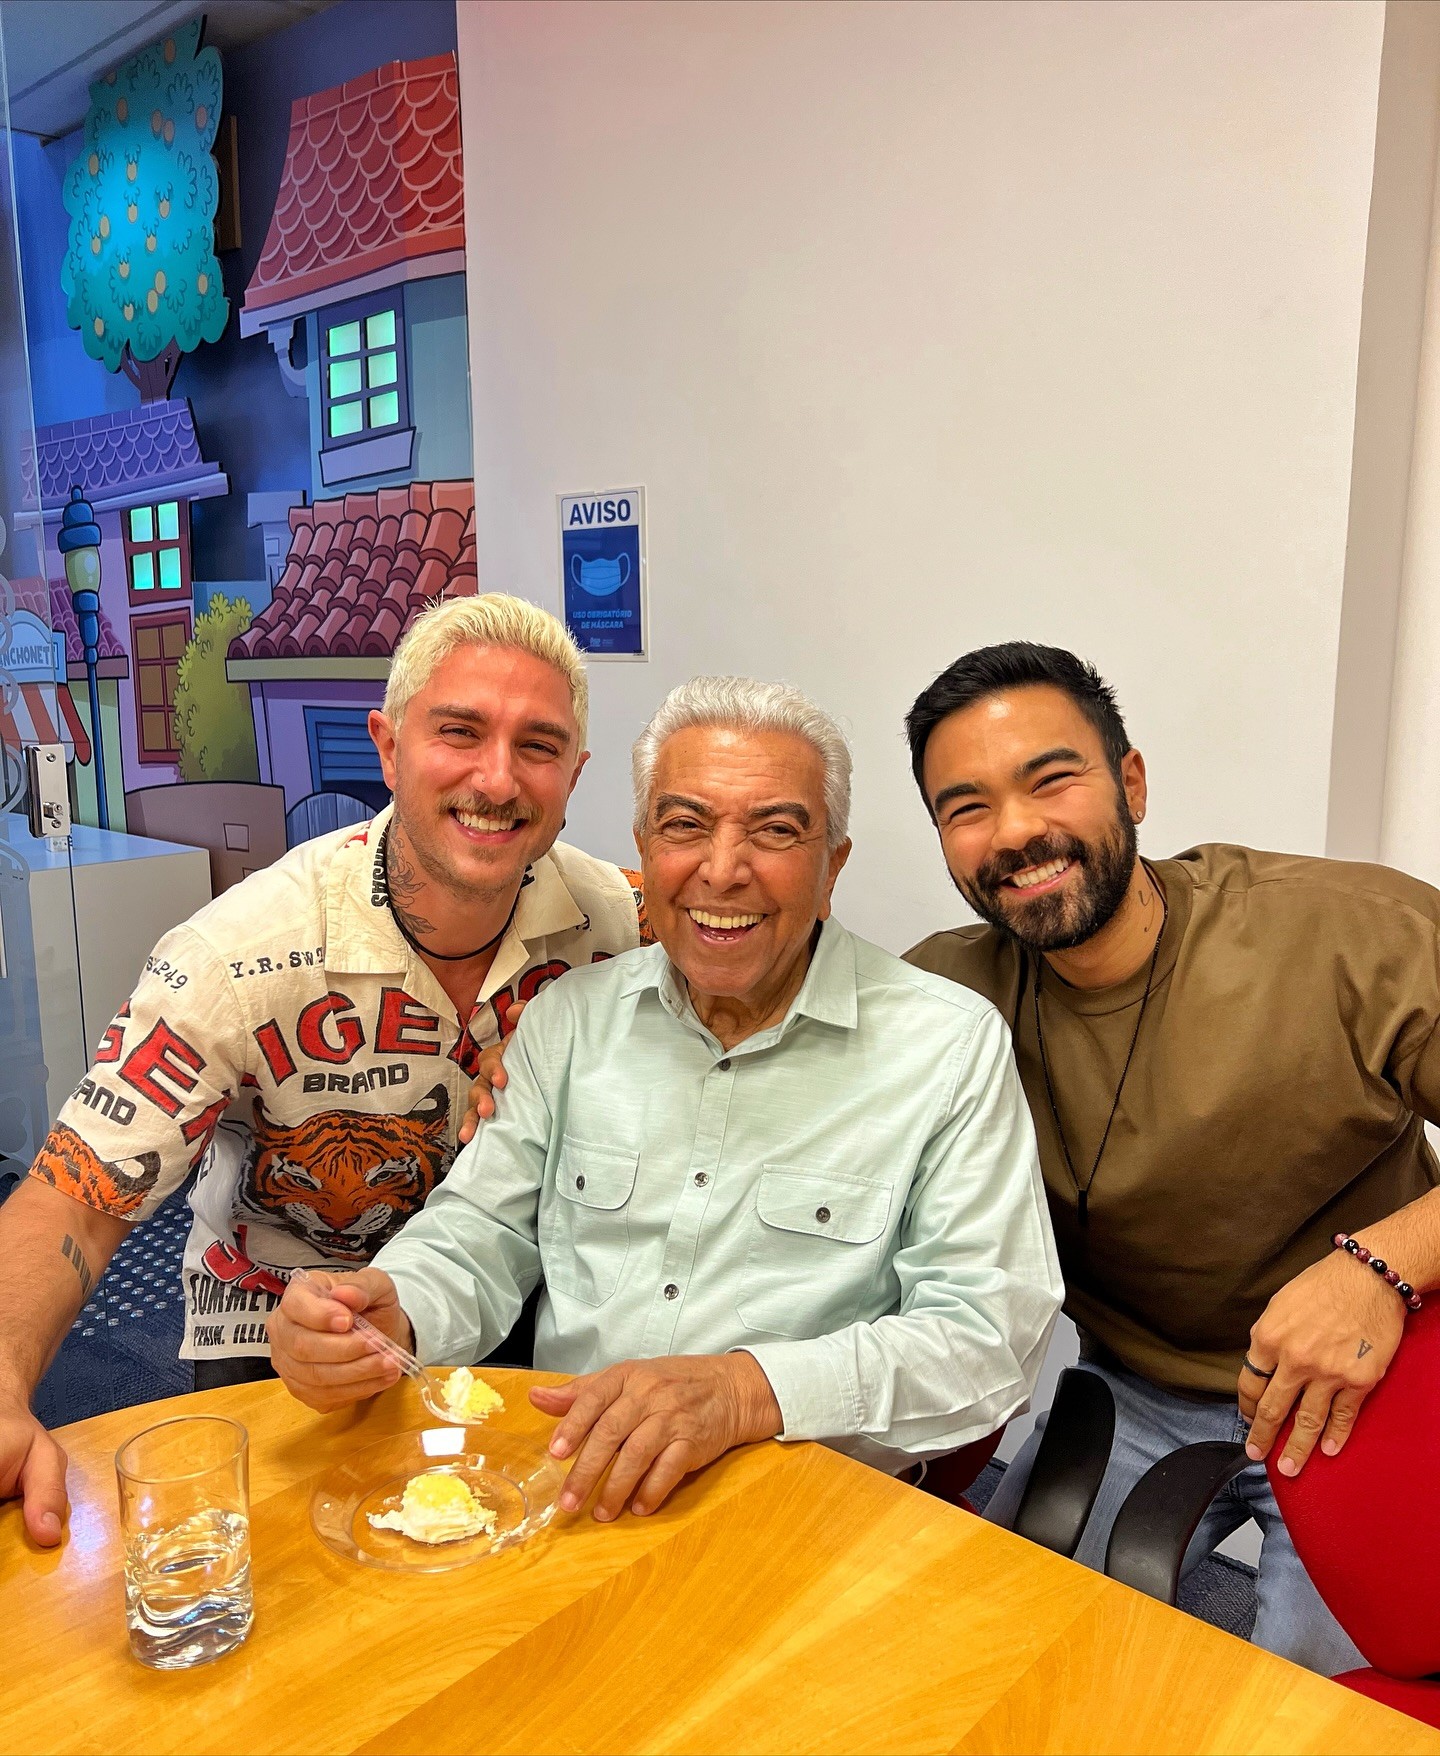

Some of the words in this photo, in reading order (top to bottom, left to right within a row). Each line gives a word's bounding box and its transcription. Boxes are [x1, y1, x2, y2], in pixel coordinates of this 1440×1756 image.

[569, 499, 631, 526] AVISO
[572, 610, 587, 619] USO
[587, 608, 632, 619] OBRIGATÓRIO
[581, 621, 591, 629] DE
[591, 619, 624, 629] MÁSCARA
[0, 645, 56, 667] NCHONET
[303, 1062, 409, 1094] BRAND
[72, 1078, 137, 1126] AND
